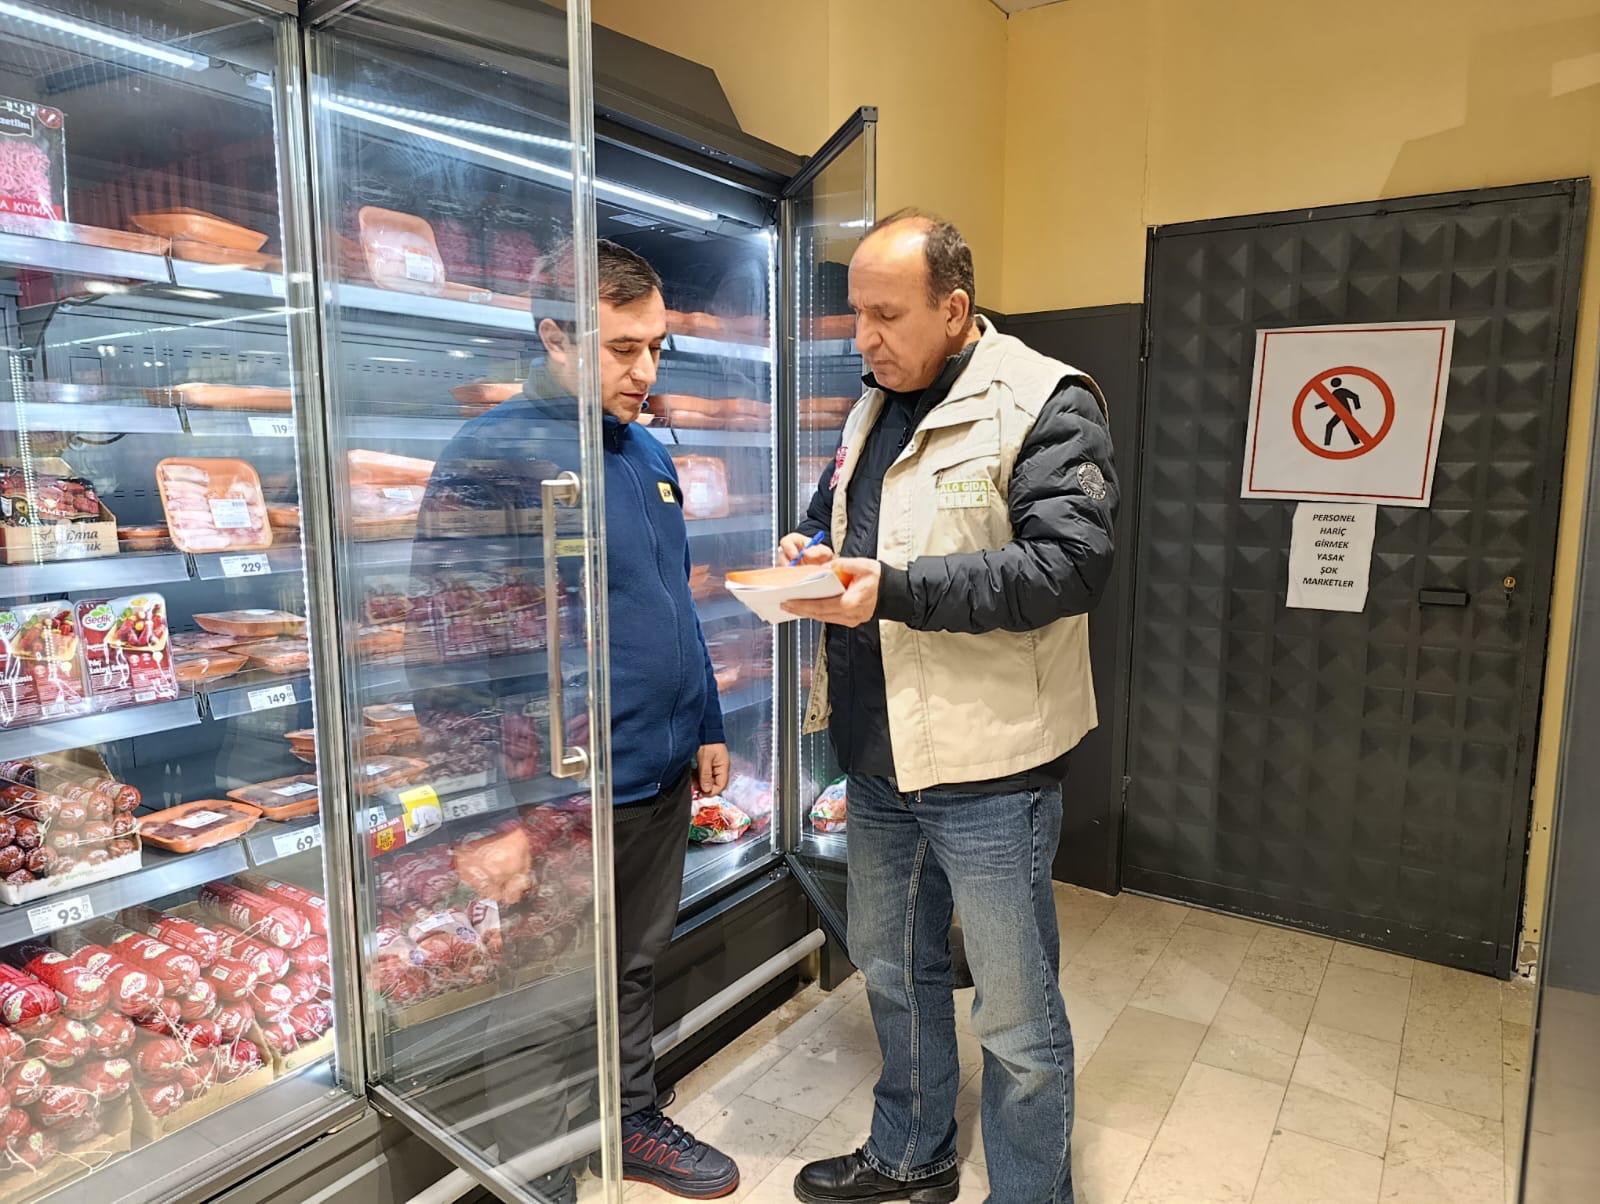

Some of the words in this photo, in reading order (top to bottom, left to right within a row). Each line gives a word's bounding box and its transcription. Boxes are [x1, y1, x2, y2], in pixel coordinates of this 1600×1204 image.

[271, 424, 288, 435] 119
[1312, 514, 1356, 522] PERSONEL
[1320, 527, 1347, 536] HARİÇ
[1314, 539, 1349, 549] GİRMEK
[1317, 553, 1345, 562] YASAK
[241, 562, 262, 573] 229
[1320, 566, 1338, 575] ŞOK
[1302, 577, 1354, 588] MARKETLER
[85, 614, 113, 626] Gedik
[267, 692, 286, 705] 149
[296, 835, 314, 851] 69
[57, 906, 82, 925] 93
